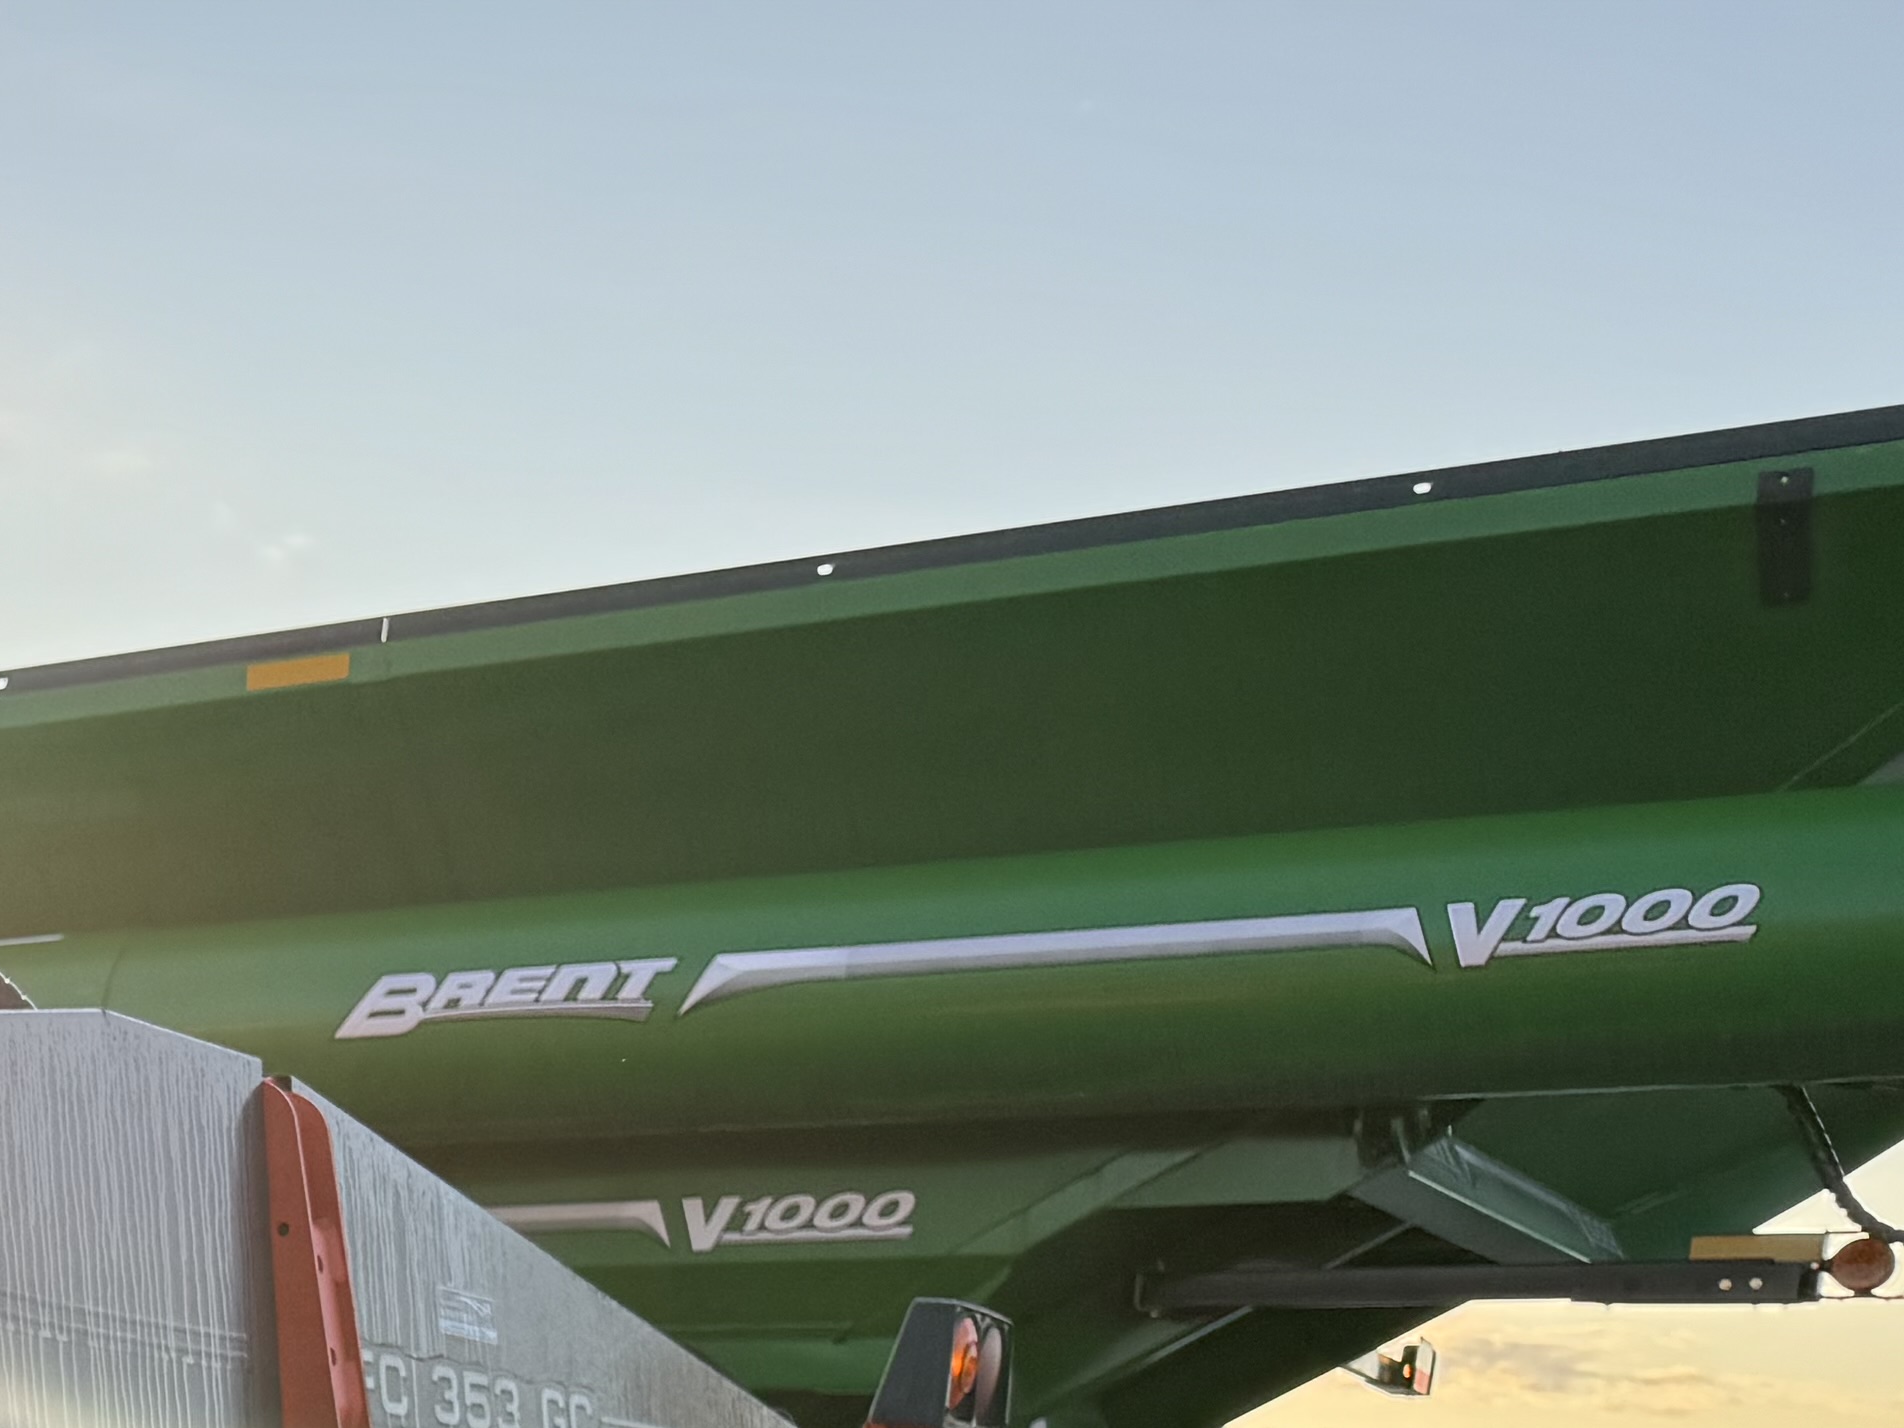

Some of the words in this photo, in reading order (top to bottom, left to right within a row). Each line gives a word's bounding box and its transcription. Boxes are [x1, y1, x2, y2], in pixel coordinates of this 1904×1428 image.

[1447, 883, 1761, 968] V1000
[335, 957, 678, 1039] BRENT
[682, 1190, 916, 1252] V1000
